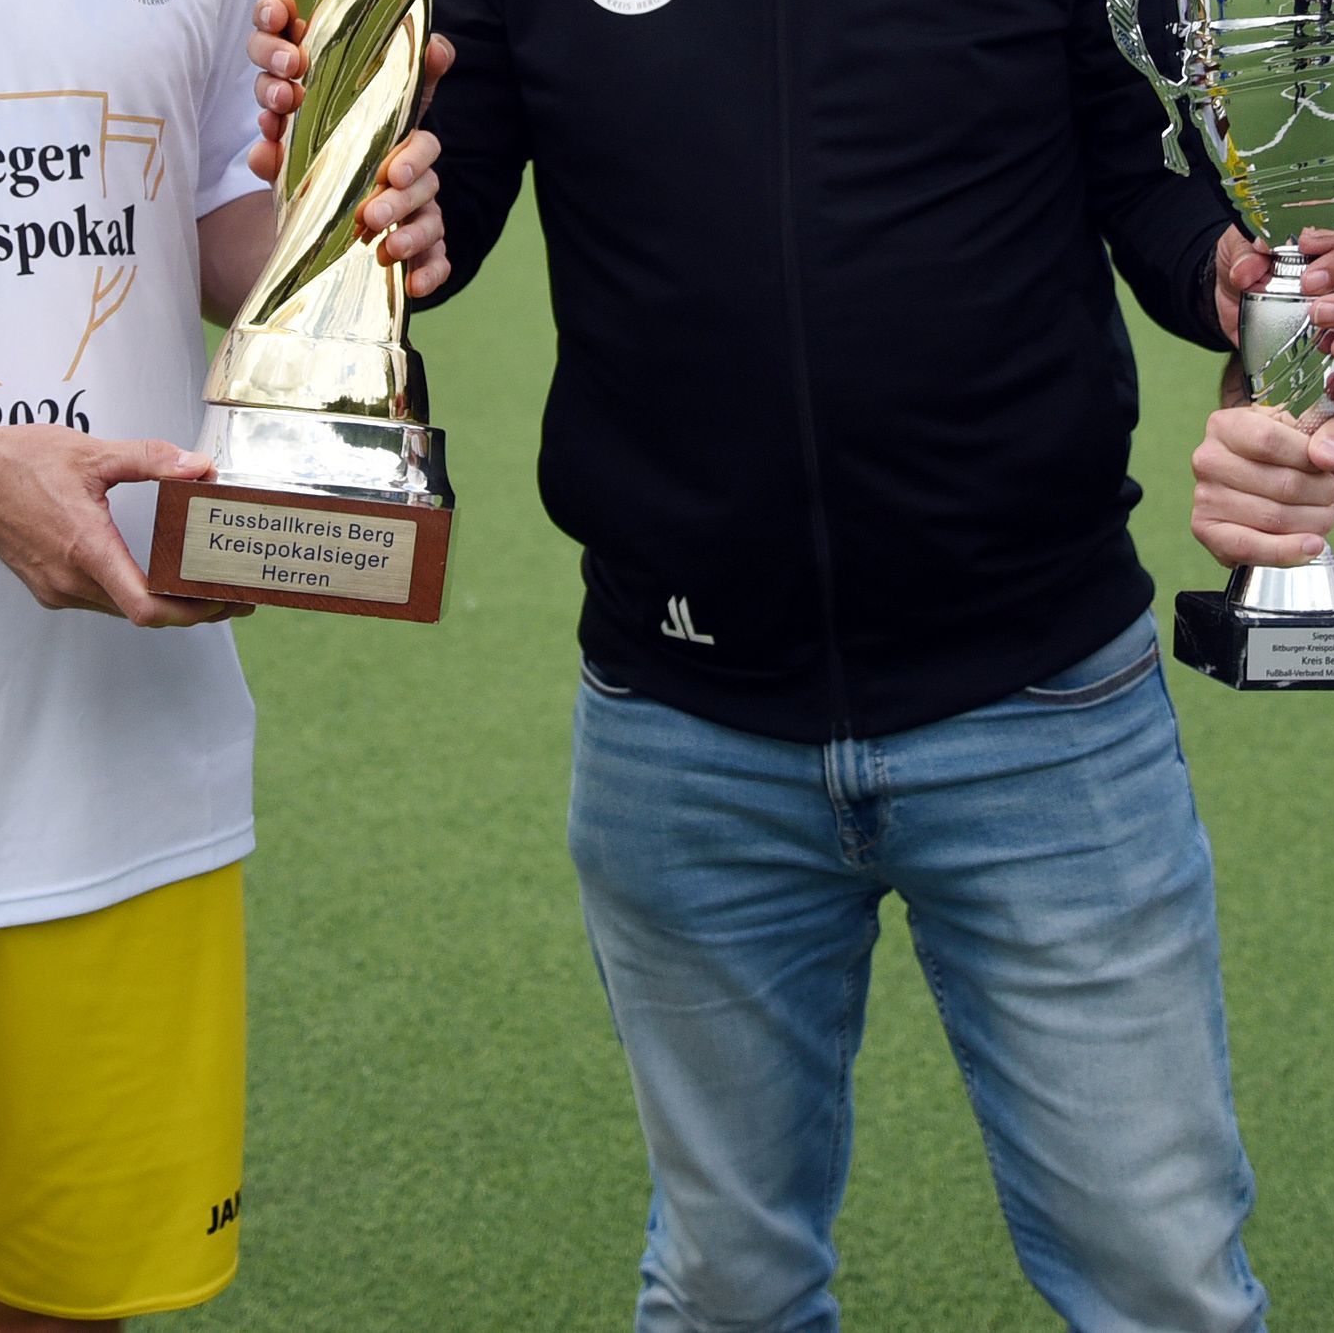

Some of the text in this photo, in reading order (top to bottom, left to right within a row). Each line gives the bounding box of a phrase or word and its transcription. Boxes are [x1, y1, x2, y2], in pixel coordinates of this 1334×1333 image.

[208, 508, 395, 548] Fussballkreis Berg
[208, 532, 390, 571] Kreispokalsieger
[262, 564, 330, 588] Herren
[1266, 669, 1324, 677] Fußball-Verband
[1301, 656, 1323, 666] Kreis
[207, 1191, 239, 1235] JA
